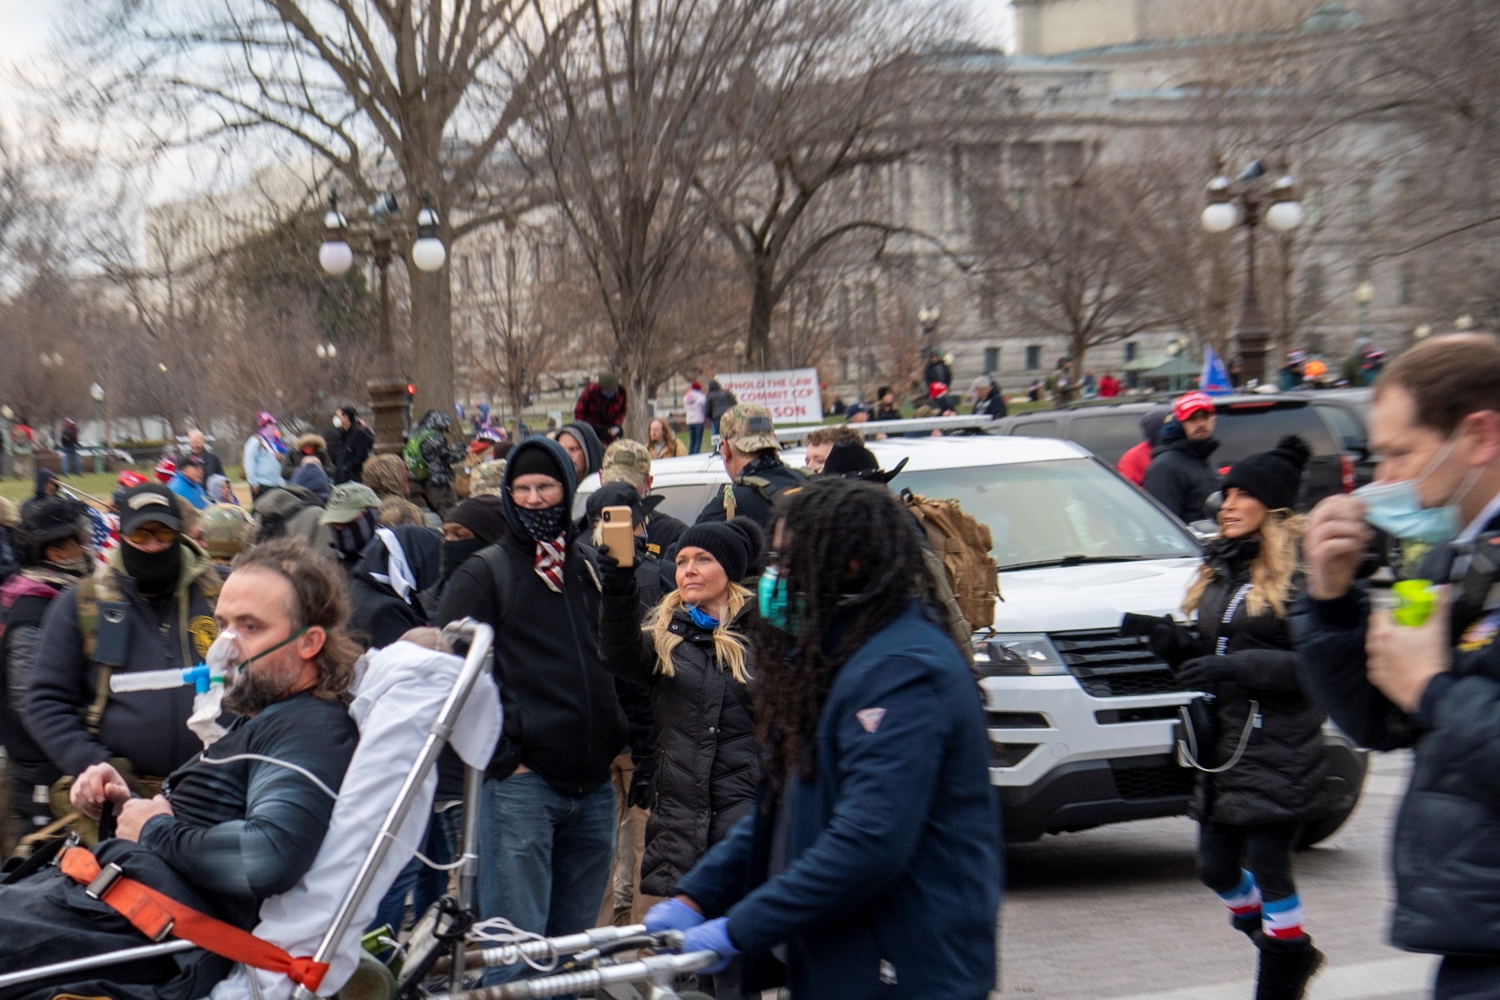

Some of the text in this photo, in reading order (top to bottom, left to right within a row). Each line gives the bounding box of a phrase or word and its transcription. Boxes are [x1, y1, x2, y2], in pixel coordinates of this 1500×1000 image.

[767, 378, 786, 387] THE
[789, 378, 812, 387] LAW
[741, 389, 813, 401] COMMIT CCP
